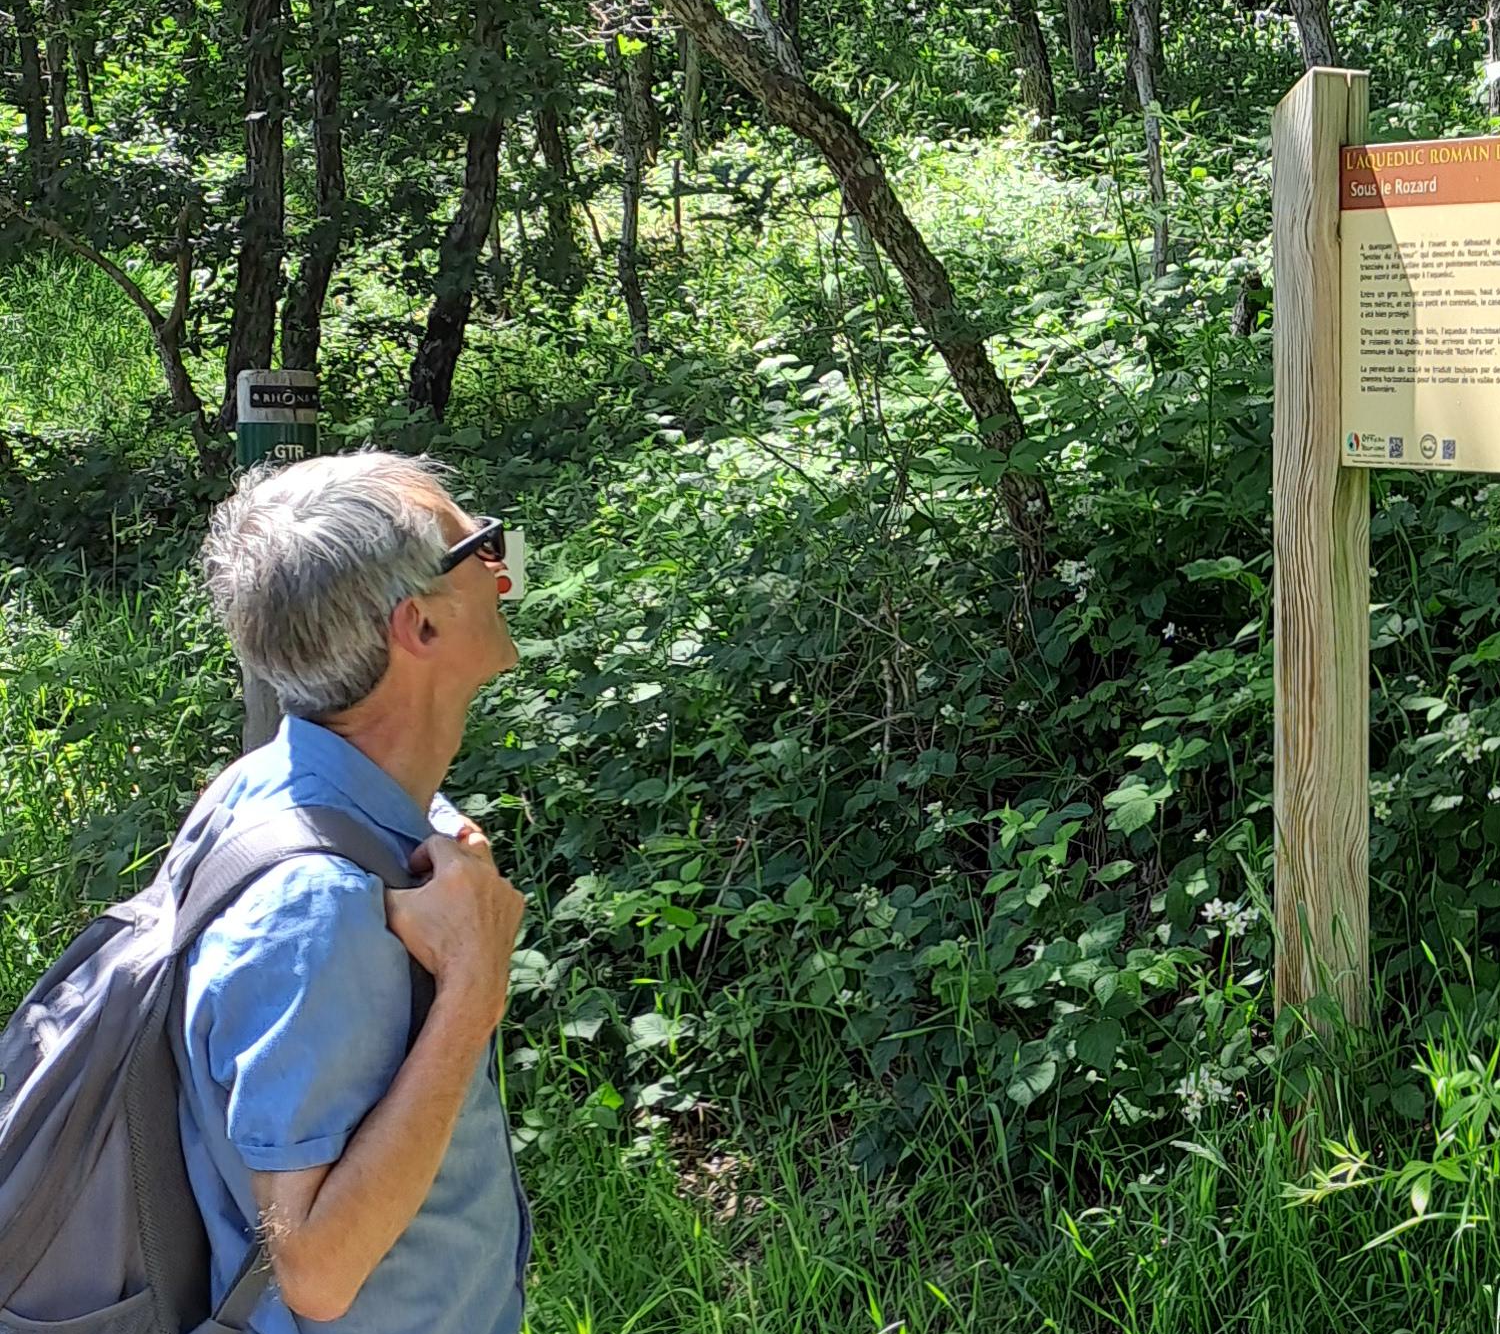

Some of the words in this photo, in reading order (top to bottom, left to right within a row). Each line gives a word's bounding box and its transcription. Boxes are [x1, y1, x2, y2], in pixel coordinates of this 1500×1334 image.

[1429, 144, 1490, 166] ROMAIN
[1350, 181, 1377, 197] Sous
[1380, 178, 1391, 195] le
[1394, 174, 1437, 194] Rozard
